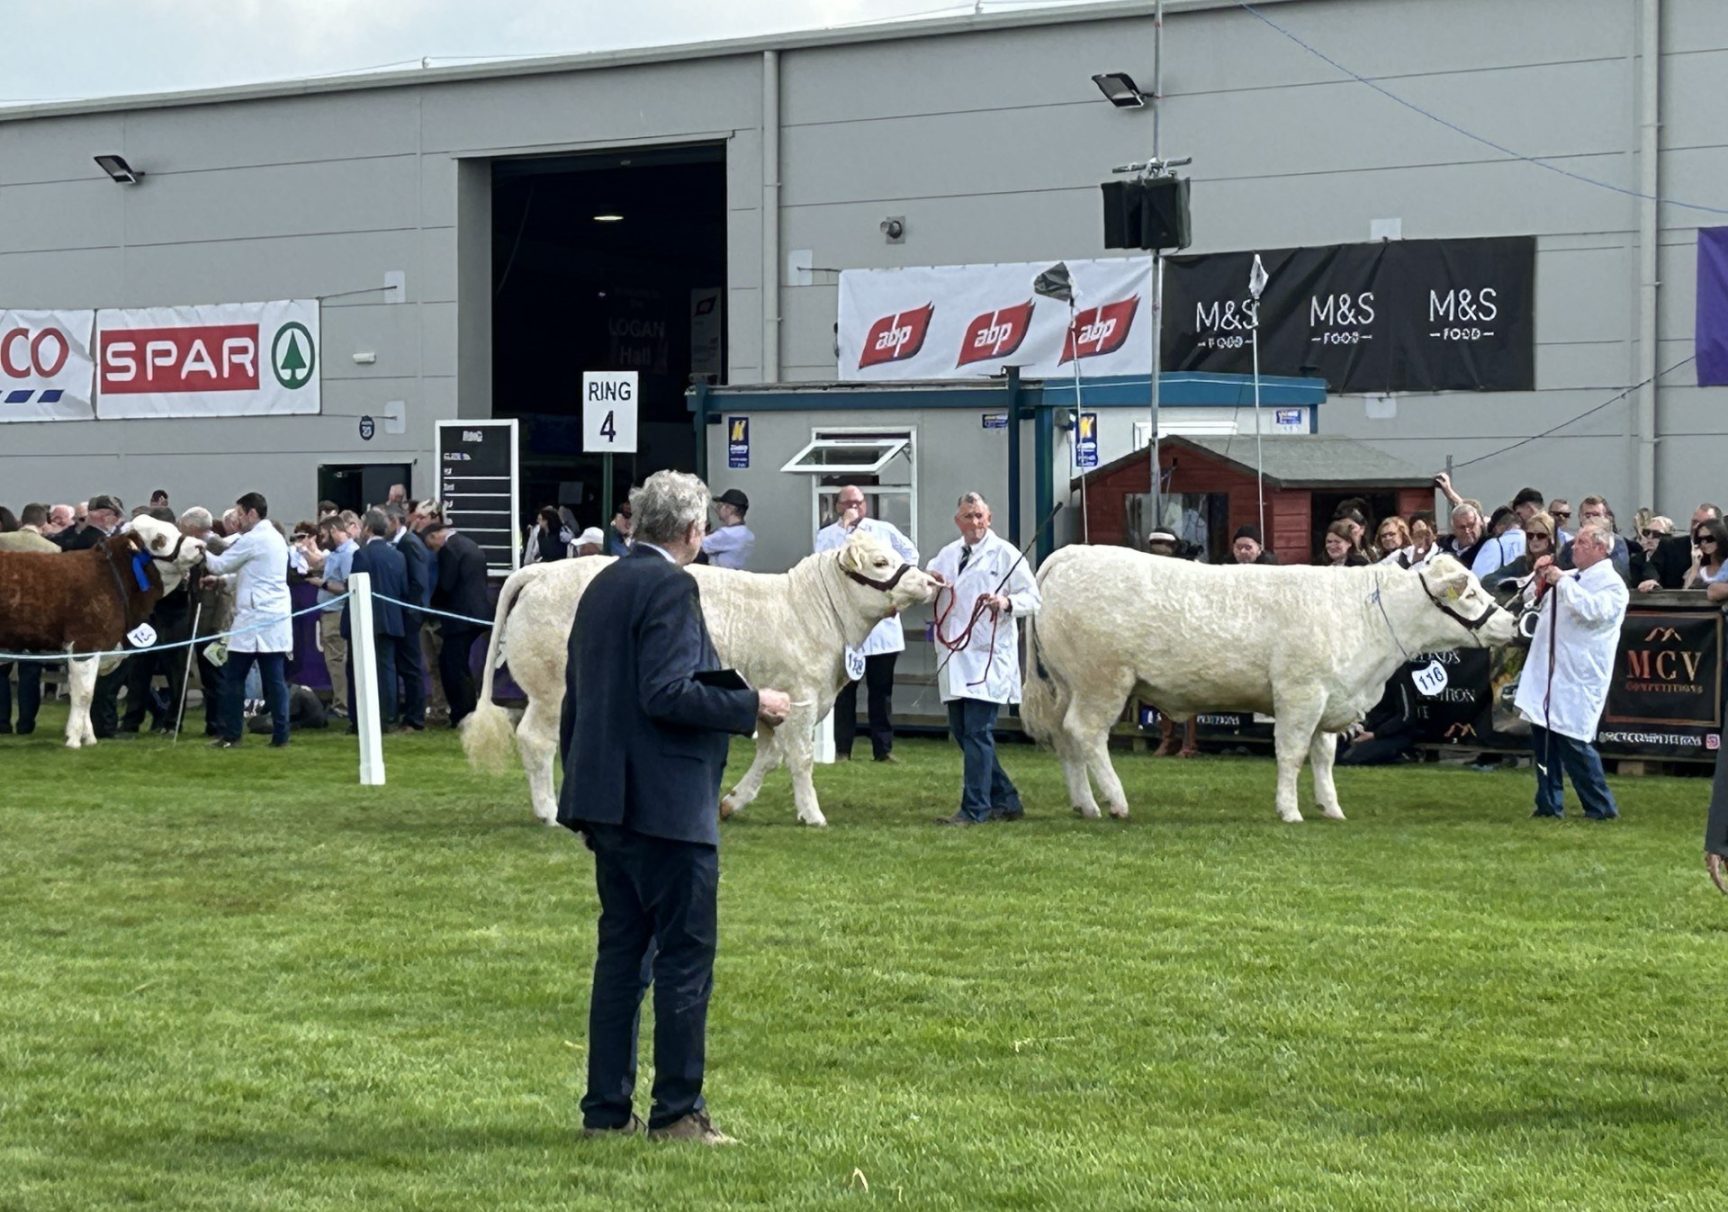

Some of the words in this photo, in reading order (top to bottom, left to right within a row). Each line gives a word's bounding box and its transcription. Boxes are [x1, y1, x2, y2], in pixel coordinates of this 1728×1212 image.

[1196, 298, 1259, 333] M&S
[1310, 292, 1375, 327] M&S
[1430, 287, 1497, 321] M&S
[875, 314, 913, 357] abp
[974, 310, 1012, 355] abp
[1078, 306, 1117, 352] abp
[1323, 332, 1359, 344] FOOD
[1443, 327, 1480, 340] FOOD
[106, 337, 255, 382] SPAR
[589, 381, 631, 401] RING
[600, 410, 616, 442] 4
[1627, 650, 1703, 681] MCV
